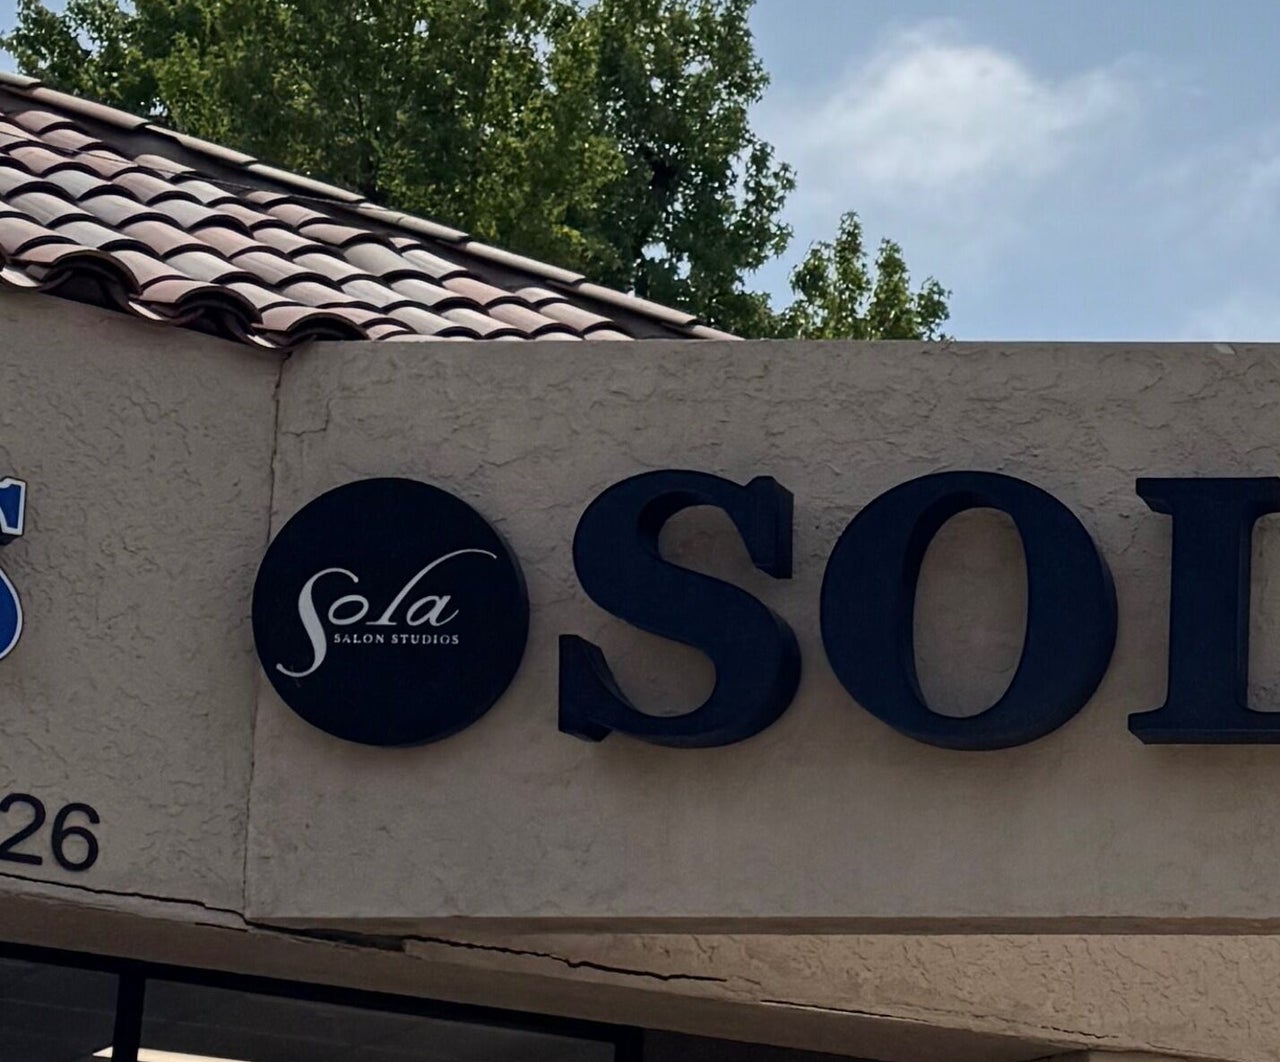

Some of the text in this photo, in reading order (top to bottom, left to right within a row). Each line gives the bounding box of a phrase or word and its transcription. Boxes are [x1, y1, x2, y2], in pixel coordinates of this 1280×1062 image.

[275, 548, 498, 678] Sola
[332, 632, 461, 646] SALON STUDIOS
